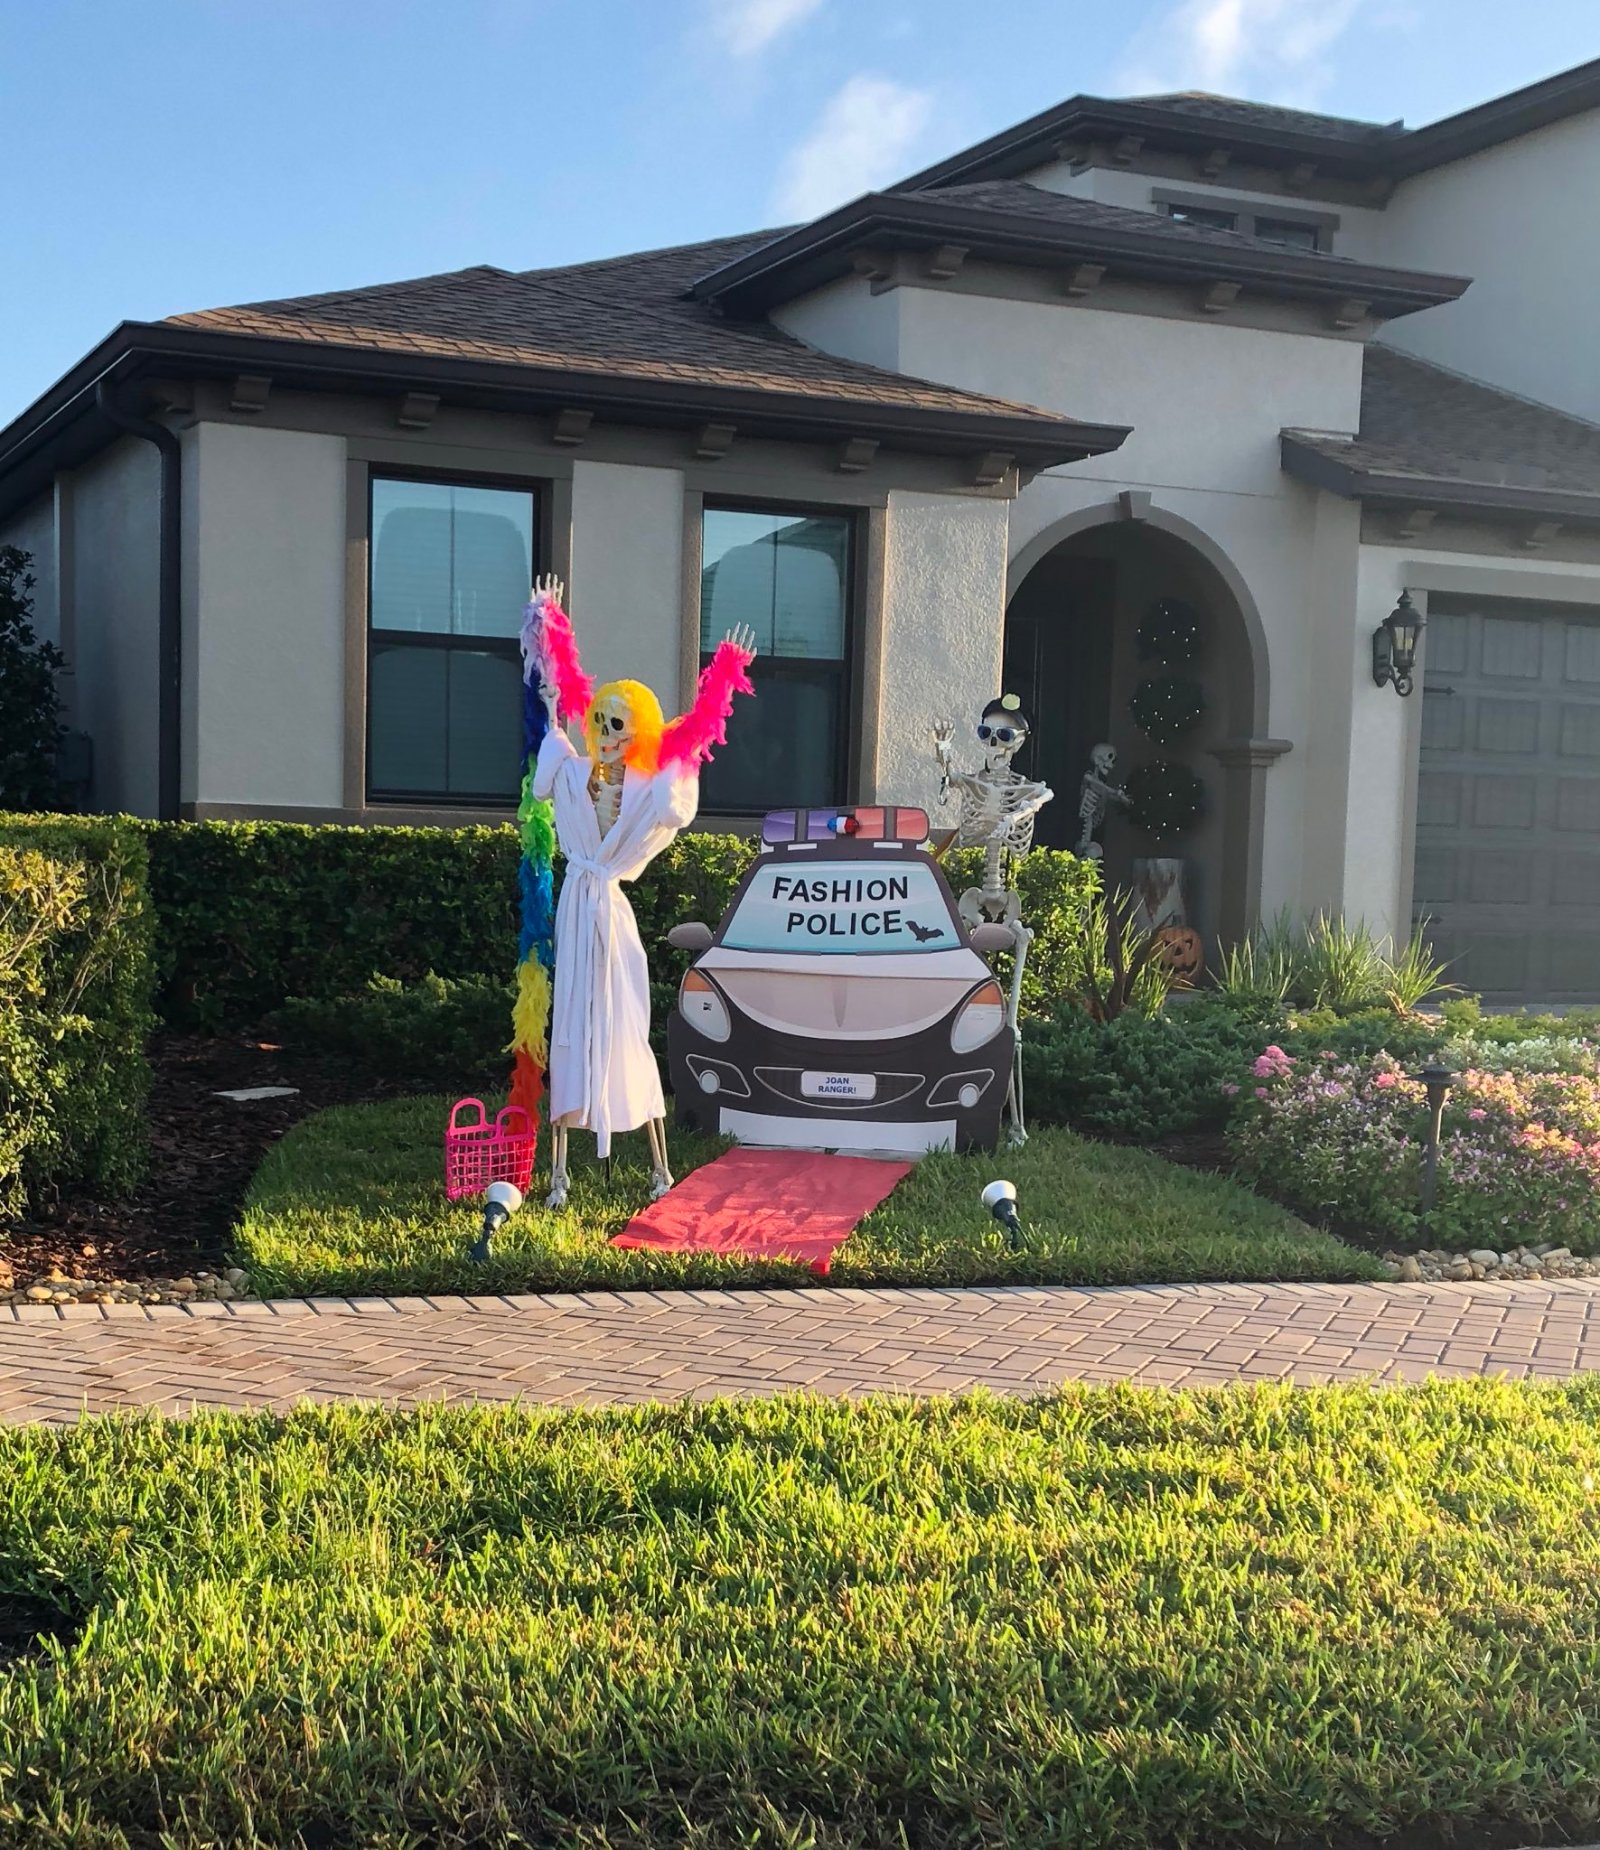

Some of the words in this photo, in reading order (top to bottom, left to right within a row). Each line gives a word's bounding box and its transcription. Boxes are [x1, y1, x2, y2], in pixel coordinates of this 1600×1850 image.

[772, 876, 908, 902] FASHION
[786, 910, 902, 935] POLICE
[825, 1076, 849, 1085] JOAN
[818, 1085, 857, 1094] RANGER!
